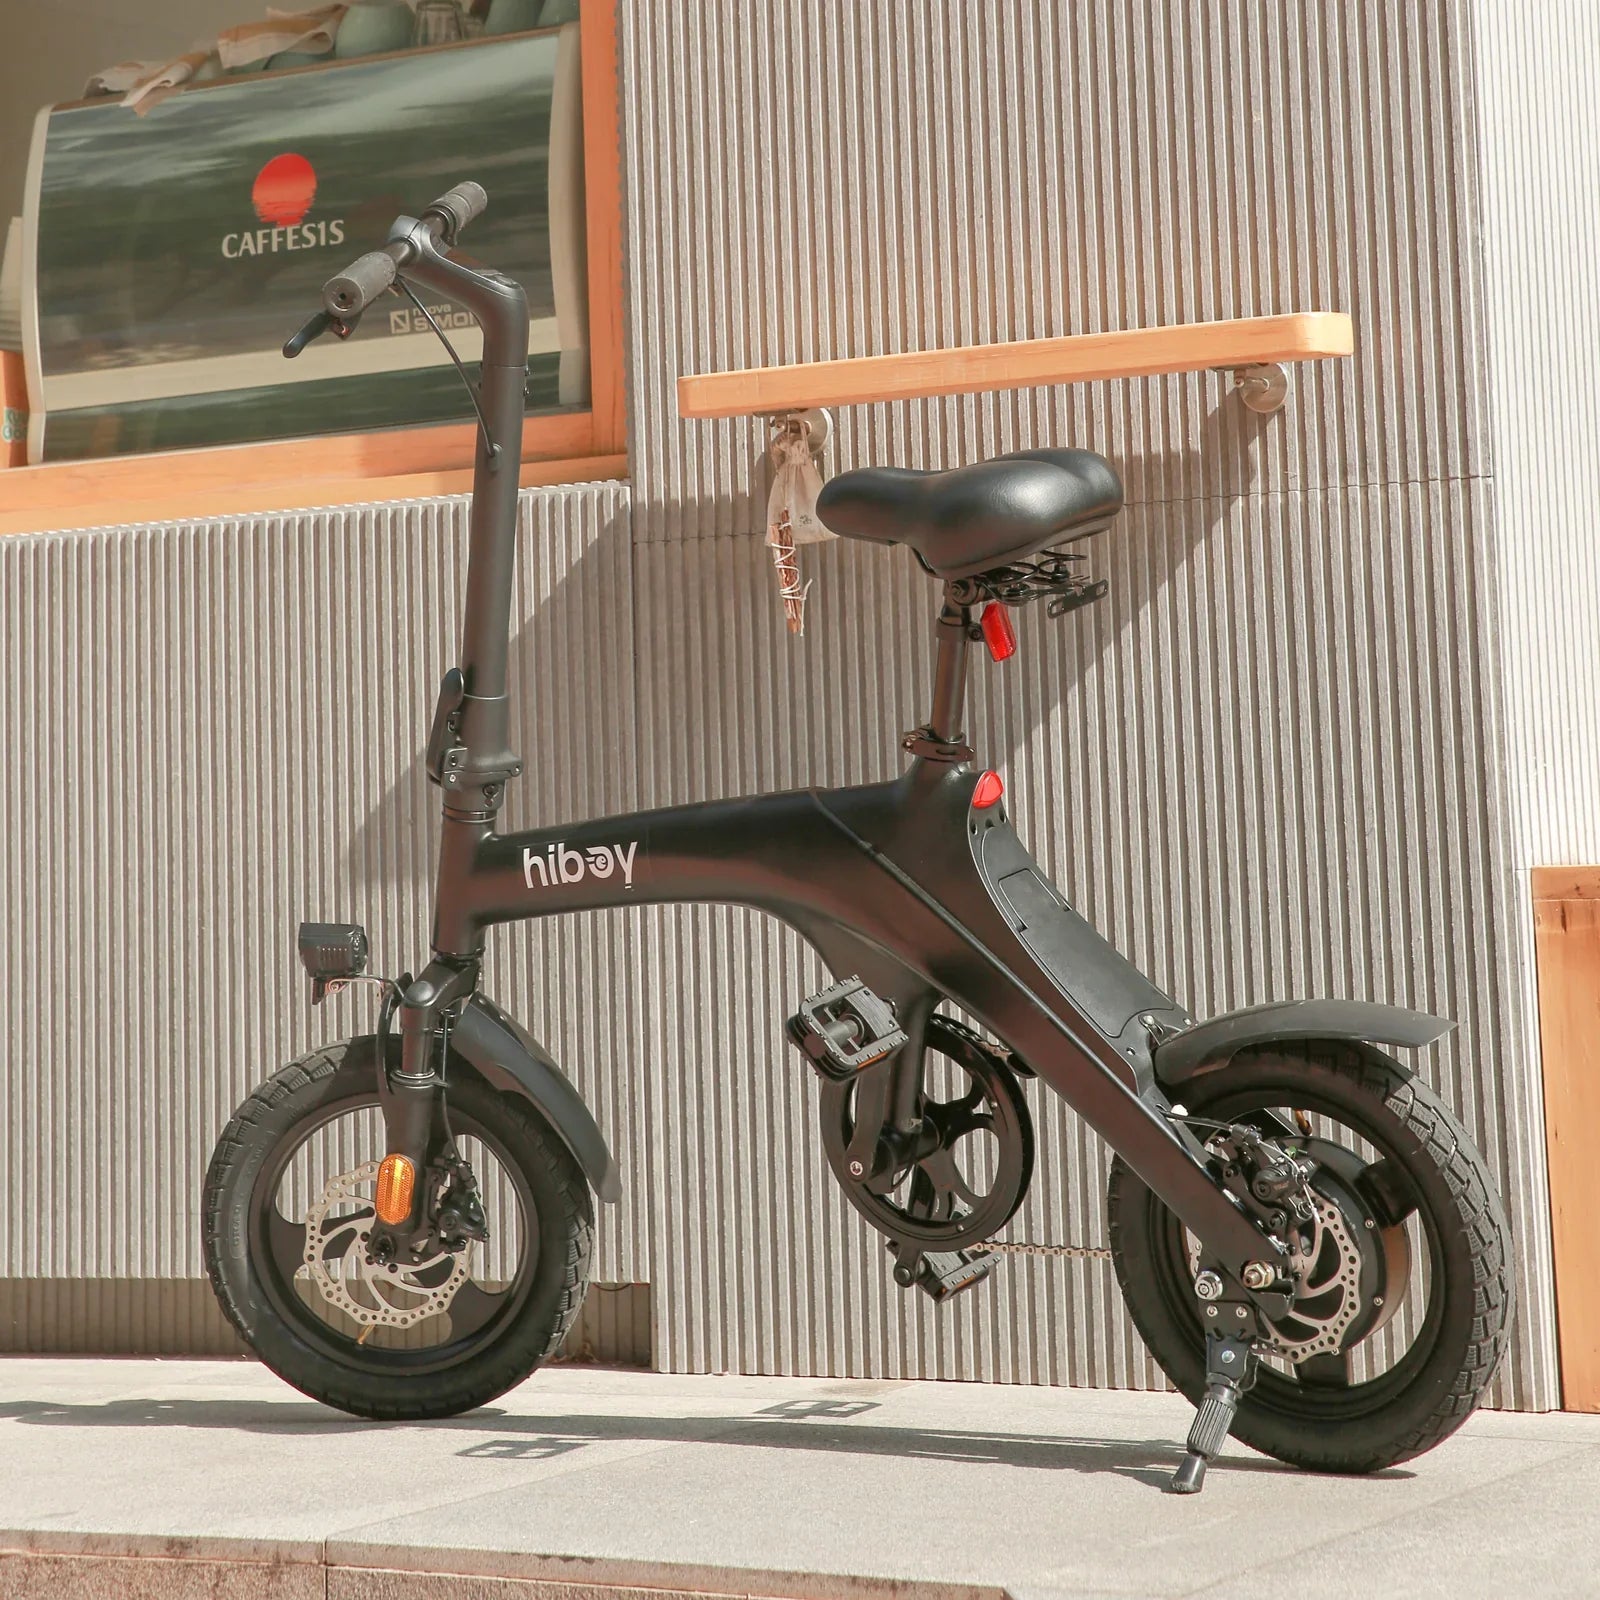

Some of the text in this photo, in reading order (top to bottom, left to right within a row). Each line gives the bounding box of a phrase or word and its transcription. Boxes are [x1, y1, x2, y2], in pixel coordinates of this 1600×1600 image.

[413, 303, 452, 317] nova
[414, 311, 476, 331] SMO
[523, 841, 638, 889] hiboy
